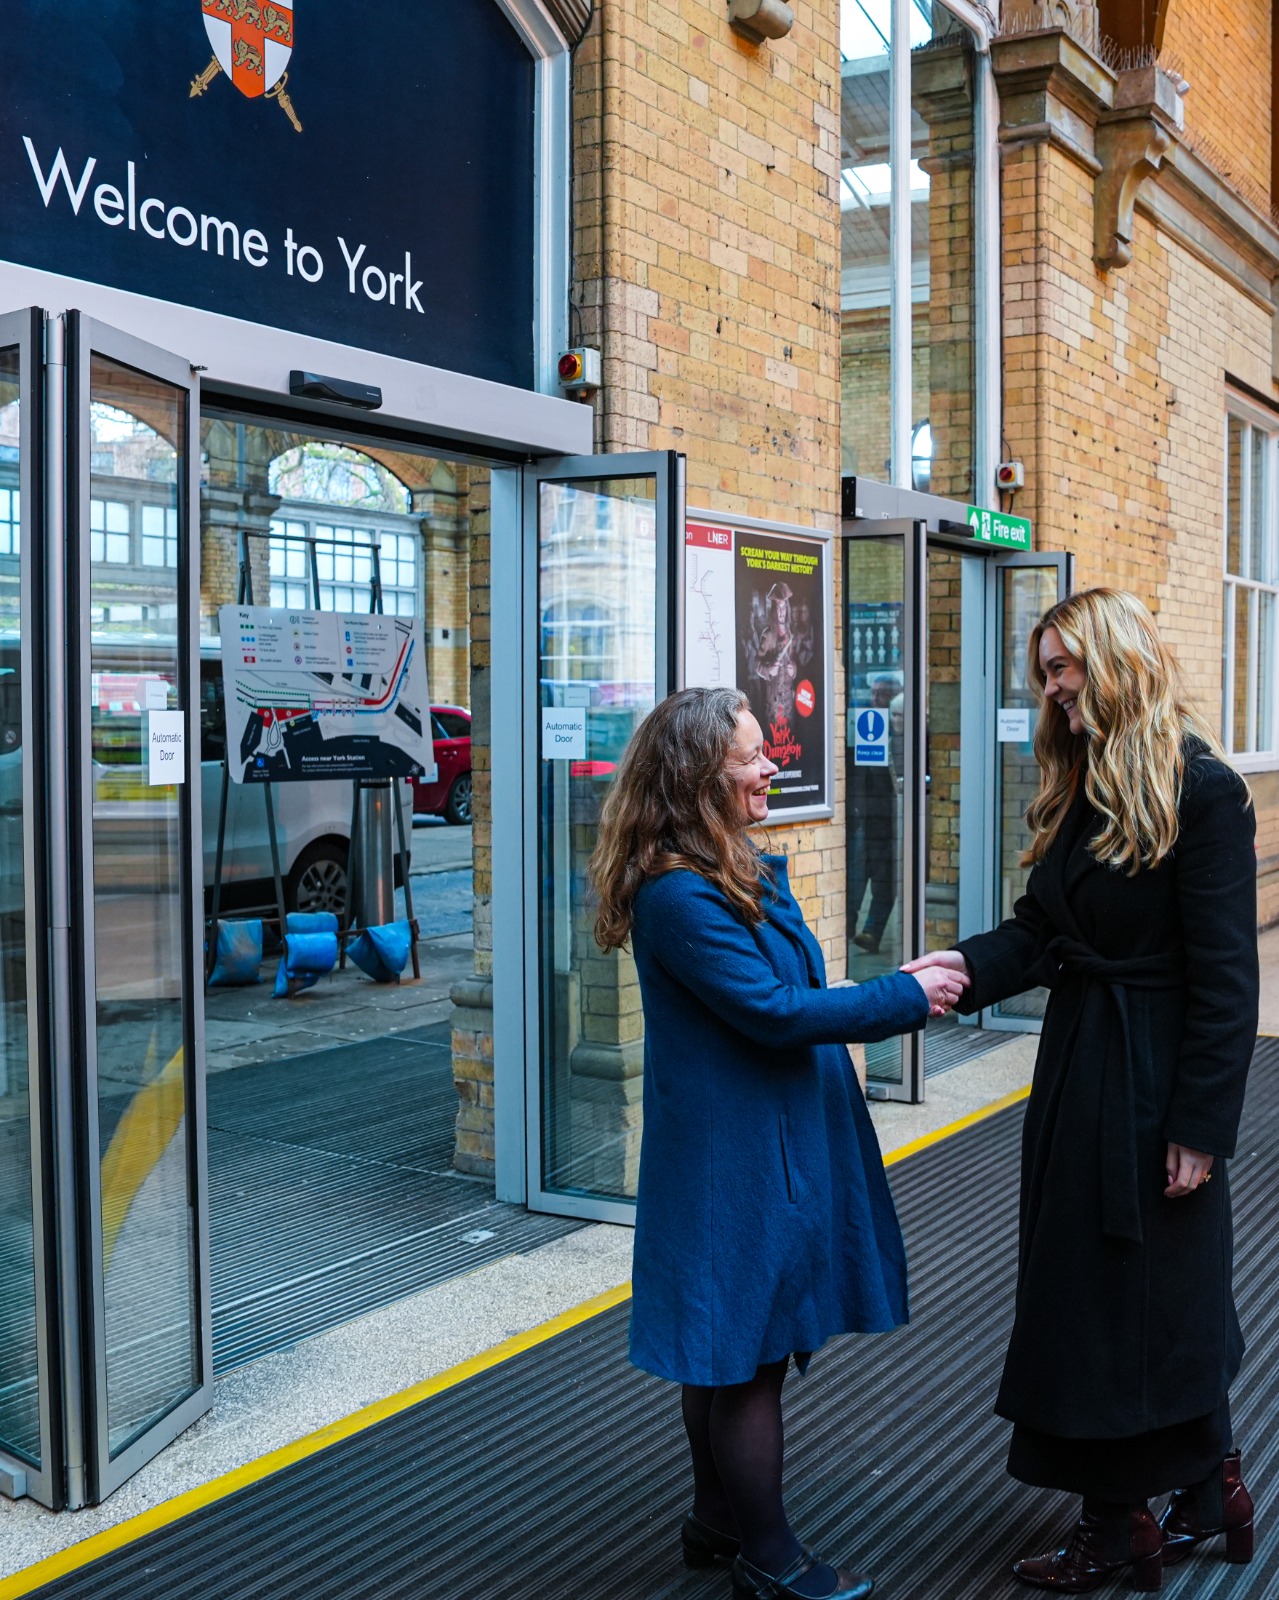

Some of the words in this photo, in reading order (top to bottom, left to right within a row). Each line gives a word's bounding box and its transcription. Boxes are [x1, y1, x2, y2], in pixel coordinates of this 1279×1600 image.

[22, 135, 269, 267] Welcome
[284, 228, 323, 282] to
[337, 236, 424, 313] York
[707, 530, 729, 545] LNER
[993, 519, 1009, 539] Fire
[1010, 525, 1026, 543] exit
[740, 546, 764, 558] SCREAM
[764, 550, 780, 561] YOUR
[780, 552, 793, 562] WAY
[793, 554, 818, 566] THROUGH
[746, 558, 766, 569] YORK'S
[766, 561, 791, 572] DARKEST
[791, 564, 814, 575] HISTORY
[545, 722, 583, 731] Automatic
[769, 722, 795, 745] York
[152, 732, 182, 743] Automatic
[555, 734, 573, 743] Door
[160, 749, 175, 761] Door
[763, 740, 802, 766] Dungeon
